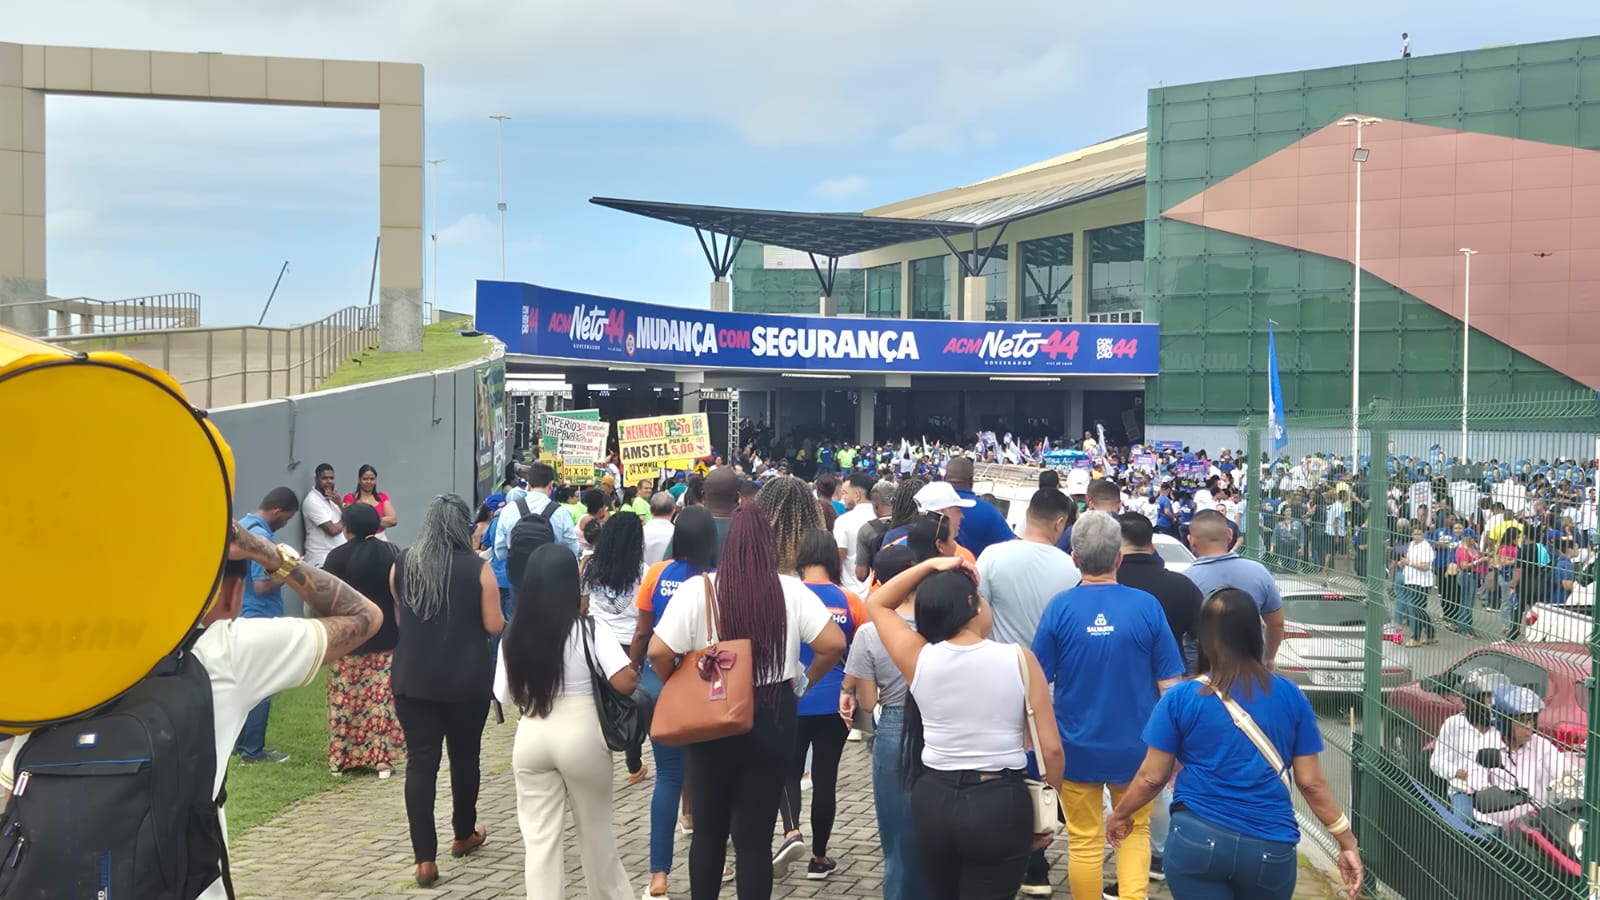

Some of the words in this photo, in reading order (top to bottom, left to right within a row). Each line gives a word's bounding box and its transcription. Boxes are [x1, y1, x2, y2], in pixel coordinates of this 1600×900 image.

[548, 312, 572, 333] ACM
[569, 304, 609, 341] Neto
[604, 307, 625, 344] 44
[636, 316, 718, 357] MUDANÇA
[718, 328, 750, 349] COM
[751, 326, 920, 363] SEGURANÇA
[943, 337, 982, 354] ACM
[978, 329, 1049, 359] Neto
[1040, 329, 1080, 359] 44
[1111, 338, 1137, 359] 44
[626, 422, 663, 440] HEINEKEN
[622, 443, 670, 460] AMSTEL
[671, 443, 694, 455] 5,00
